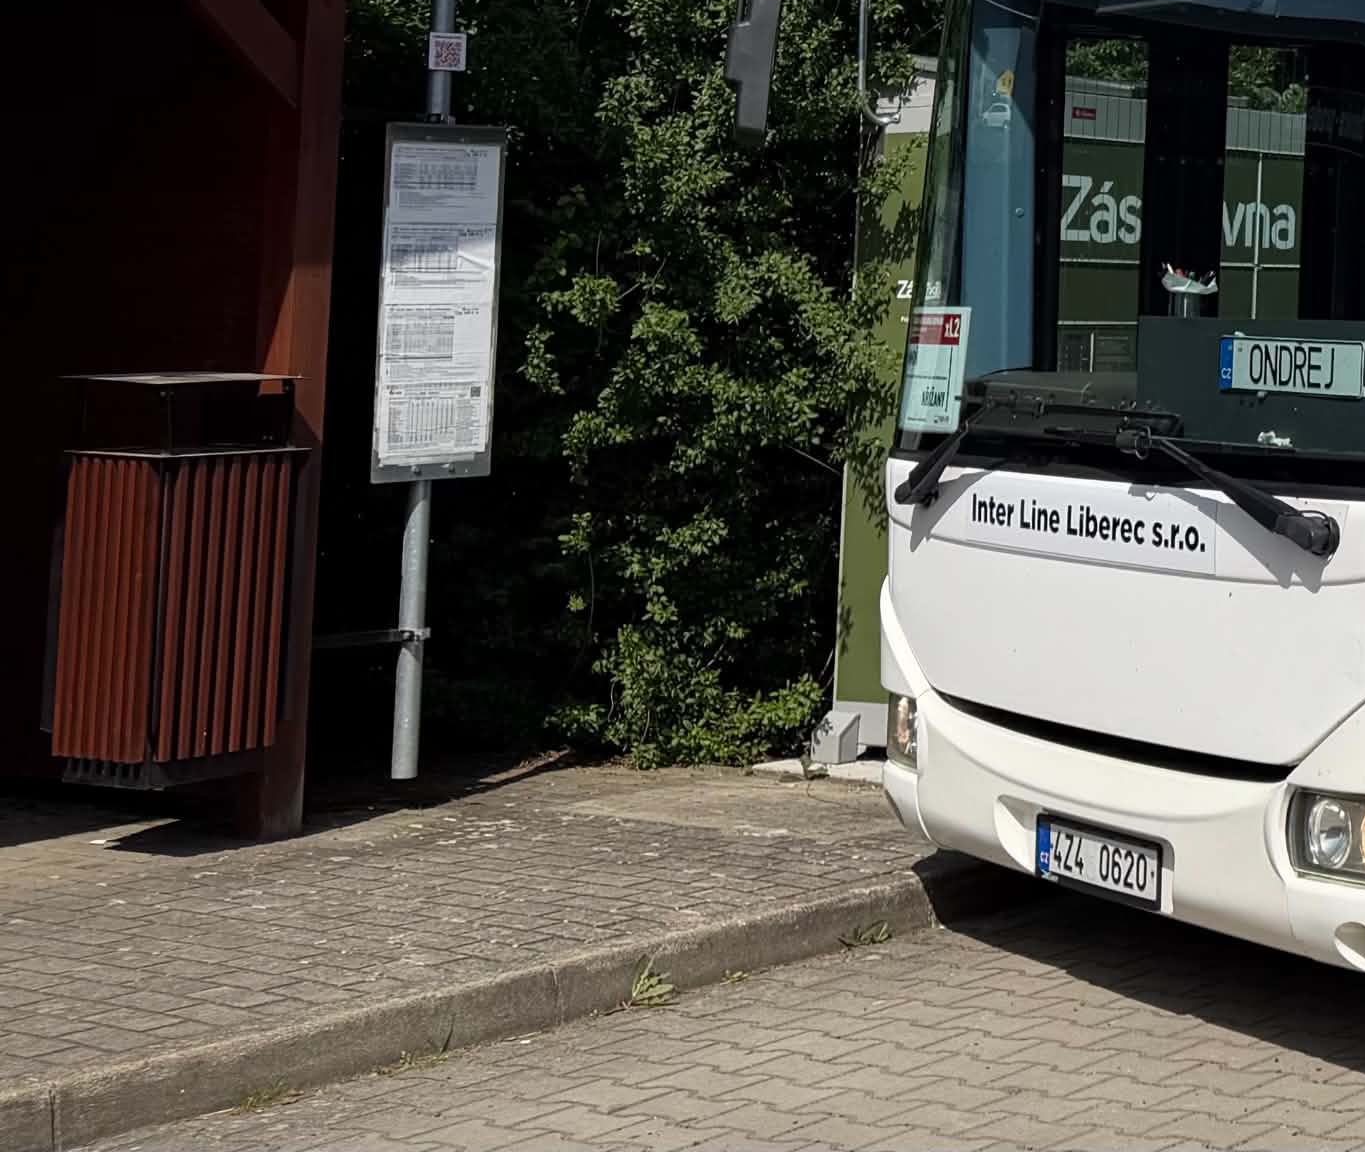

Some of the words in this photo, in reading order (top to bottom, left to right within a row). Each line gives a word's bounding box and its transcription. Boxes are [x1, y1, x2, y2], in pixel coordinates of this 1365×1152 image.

[972, 493, 1015, 527] Inter
[1020, 499, 1060, 534] Line
[1066, 505, 1146, 545] Liberec
[1151, 521, 1206, 553] s.r.o.
[1053, 831, 1084, 875] 4Z4
[1099, 844, 1148, 891] 0620
